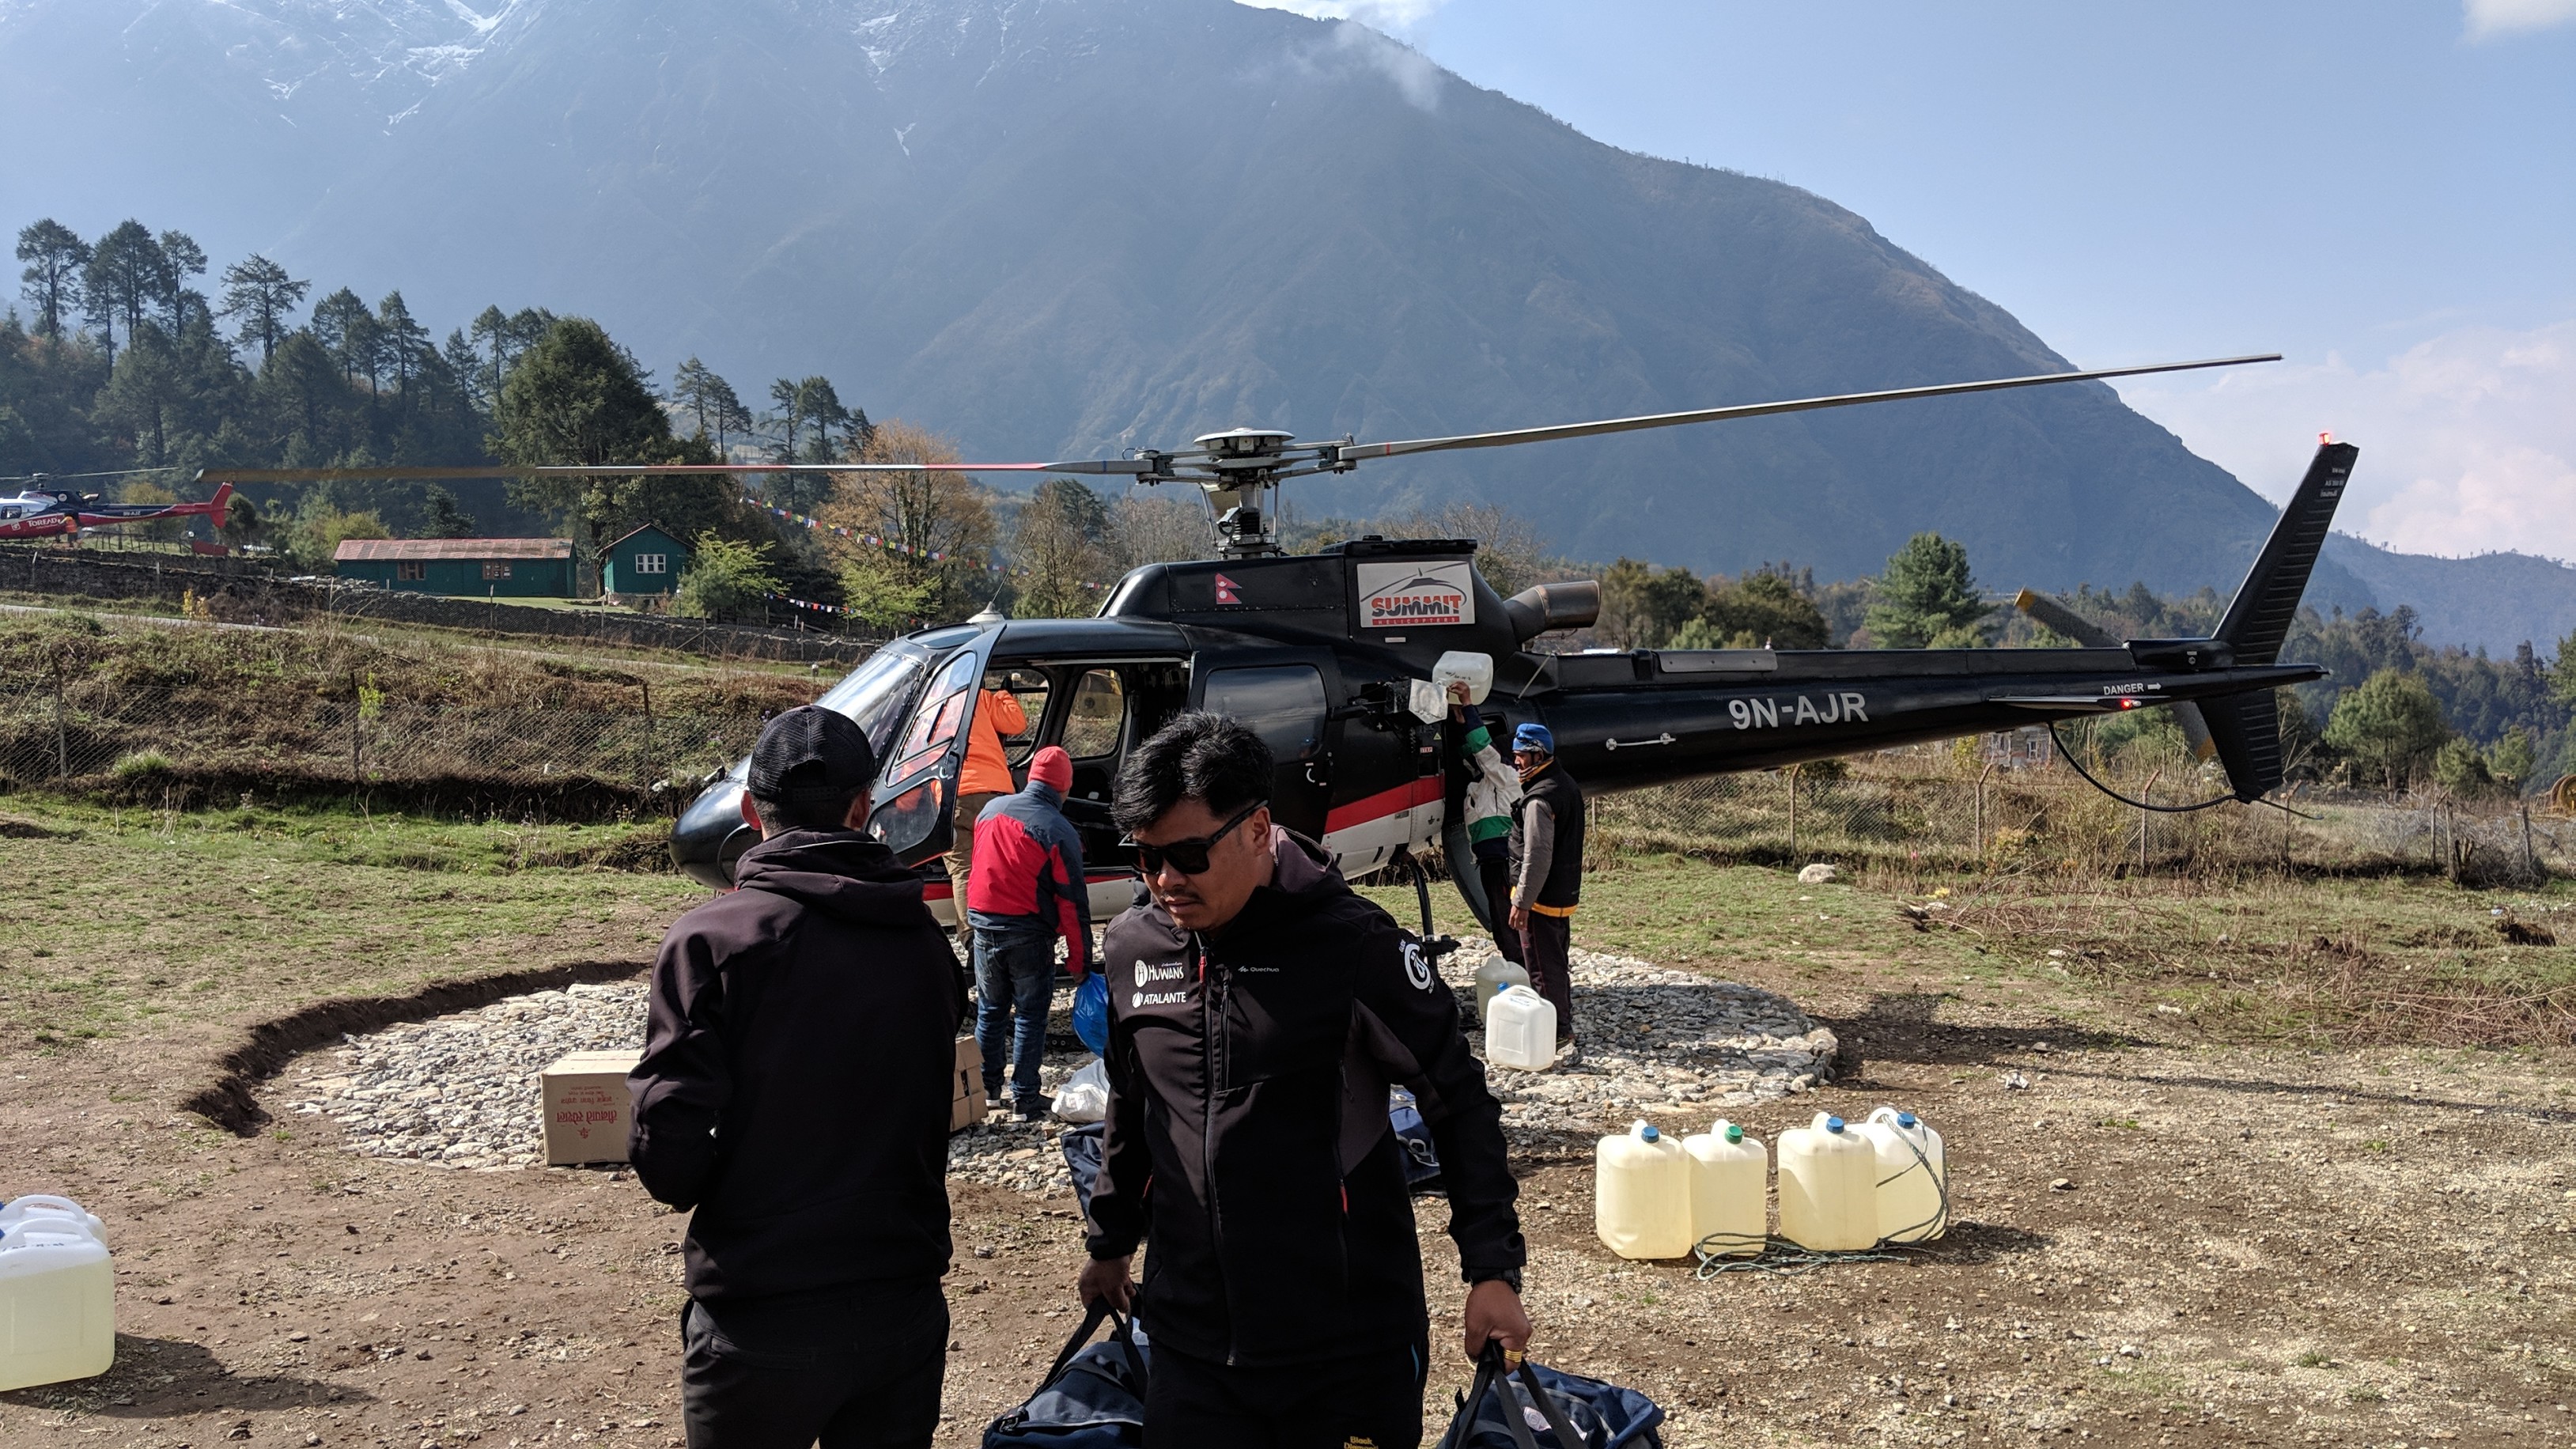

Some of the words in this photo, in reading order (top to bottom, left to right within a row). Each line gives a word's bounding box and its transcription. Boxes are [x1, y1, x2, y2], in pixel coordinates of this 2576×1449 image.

[1371, 595, 1462, 617] SUMMIT
[2102, 683, 2144, 695] DANGER
[1728, 693, 1869, 729] 9N-AJR
[1148, 964, 1184, 982] HUWANS
[1143, 992, 1186, 1005] ATALANTE
